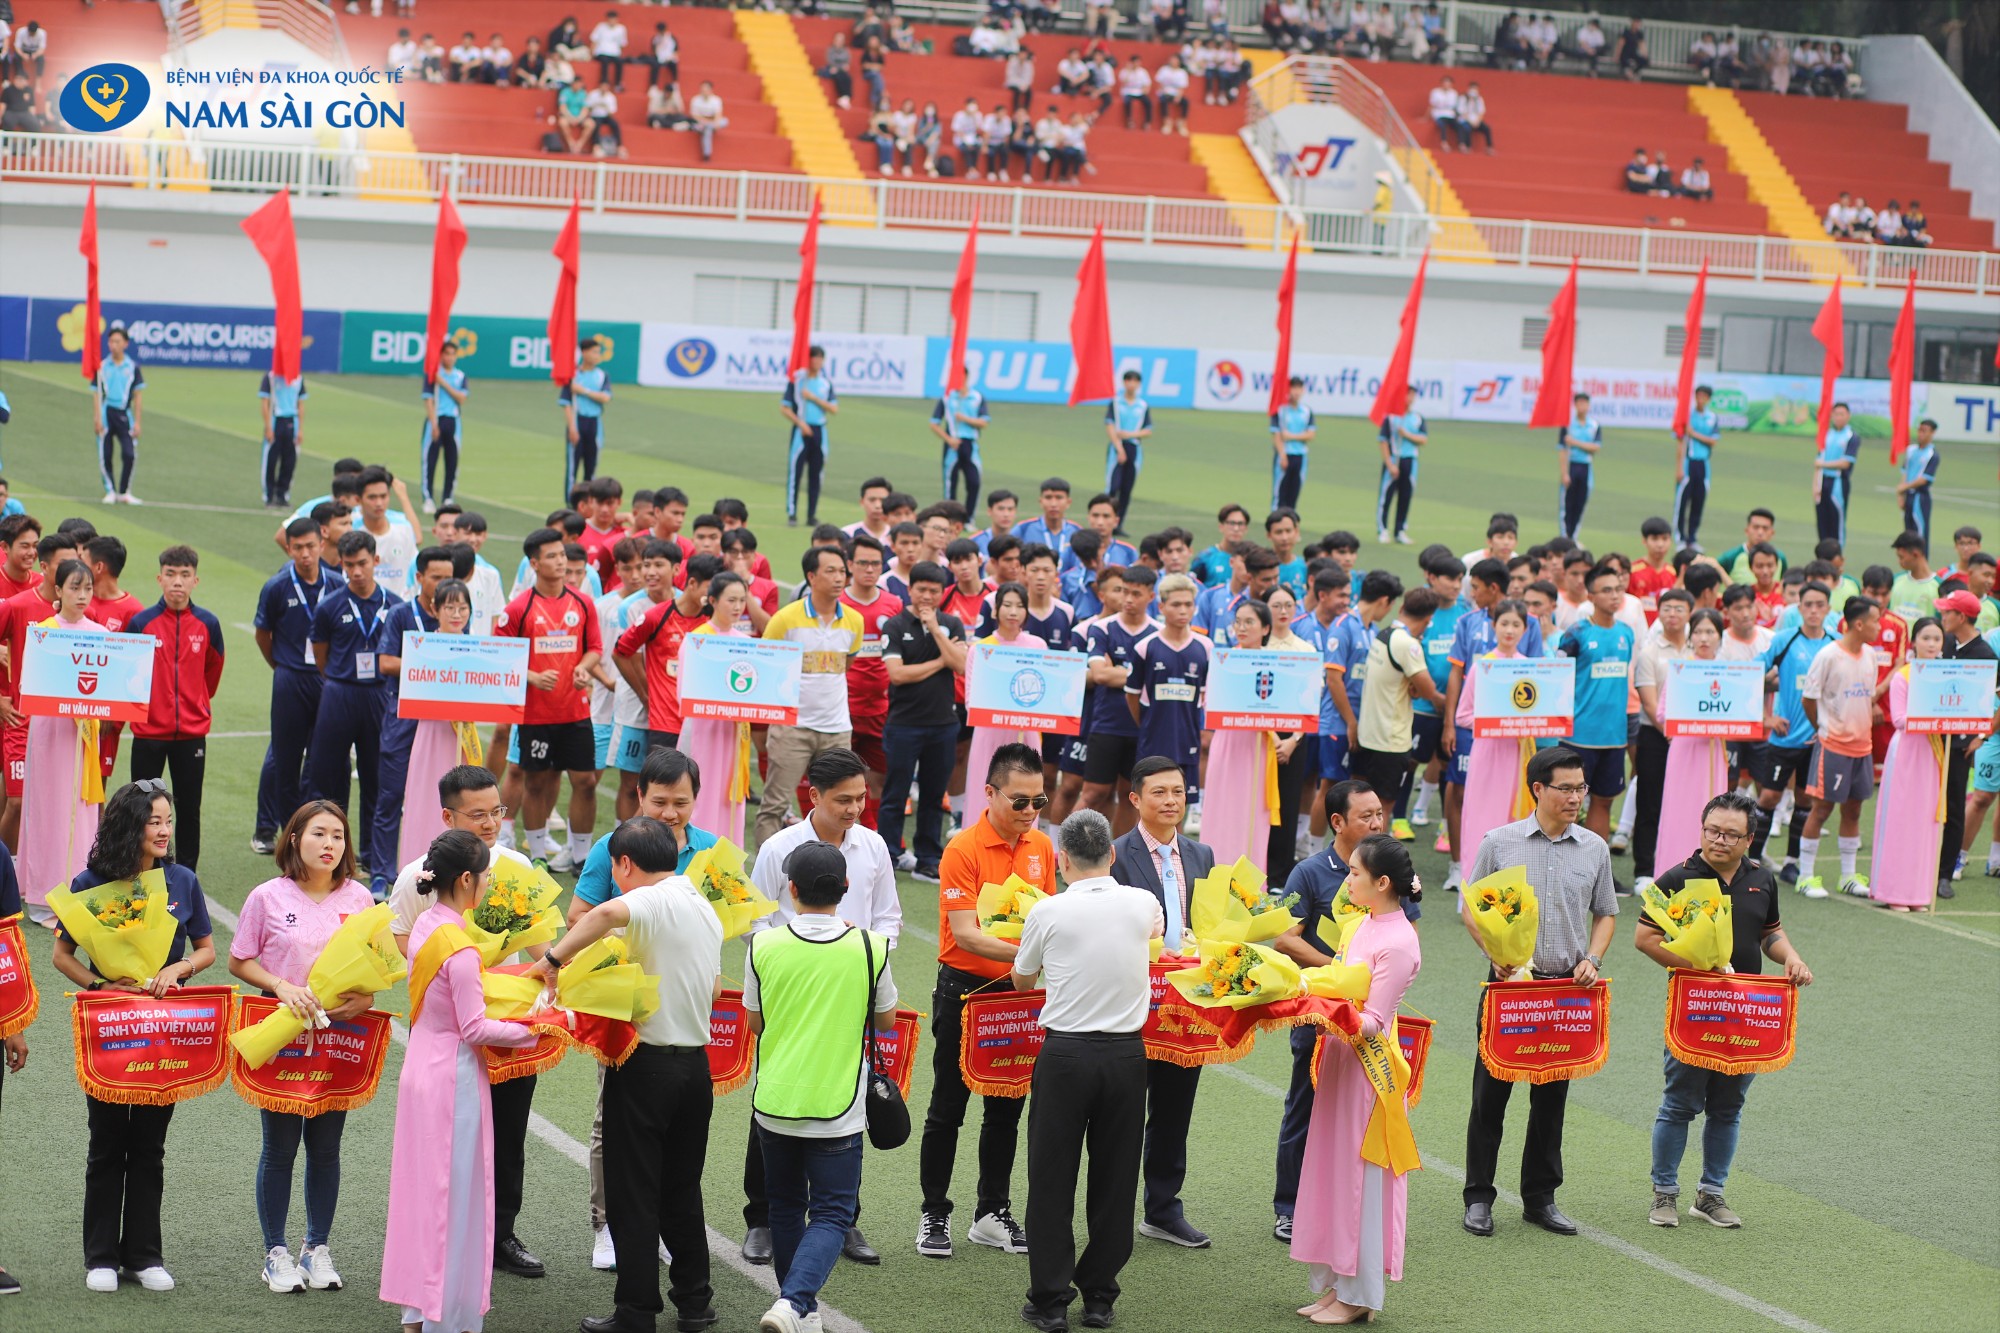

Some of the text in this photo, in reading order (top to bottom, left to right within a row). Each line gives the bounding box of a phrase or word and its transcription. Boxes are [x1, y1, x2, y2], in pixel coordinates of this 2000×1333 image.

[371, 330, 448, 364] BID
[847, 351, 906, 381] GÒN
[939, 349, 1181, 398] BULAL
[538, 640, 573, 649] THACO
[71, 653, 109, 667] VLU
[408, 665, 520, 688] GIÁM SÁT, TRỌNG TÀI
[1699, 701, 1732, 713] DHV
[1940, 695, 1964, 706] UEF
[59, 702, 110, 717] ĐH VĂN LANG
[718, 705, 739, 718] PHẠM
[531, 740, 549, 759] 23
[627, 740, 641, 758] 10
[10, 760, 25, 780] 19
[1773, 765, 1781, 781] 1
[1979, 763, 1994, 779] 23
[1833, 774, 1843, 791] 7
[0, 972, 17, 984] CO
[1689, 988, 1745, 1001] GIẢI BÓNG ĐÁ
[1501, 998, 1554, 1010] GIẢI BÓNG ĐÁ
[1687, 1000, 1782, 1017] SINH VIÊN VIỆT NAM
[98, 1010, 120, 1023] GIẢI
[122, 1009, 153, 1020] BÓNG
[154, 1008, 168, 1019] ĐÁ
[979, 1012, 994, 1023] GIẢI
[995, 1010, 1017, 1022] BÓNG
[1018, 1009, 1028, 1019] ĐÁ
[1500, 1008, 1592, 1023] SINH VIÊN VIỆT NAM
[98, 1020, 215, 1038] SINH VIÊN VIỆT NAM
[710, 1024, 736, 1035] NAM
[978, 1025, 999, 1036] SINH
[1000, 1021, 1020, 1034] VIÊN
[1553, 1024, 1591, 1032] THACO
[1745, 1018, 1781, 1029] THACO
[170, 1037, 212, 1046] THACO
[336, 1035, 365, 1050] NAM
[706, 1038, 734, 1047] ACO
[326, 1049, 361, 1064] THACO
[125, 1058, 188, 1073] Lưu Niệm
[1356, 1043, 1386, 1092] UNIVERSITY
